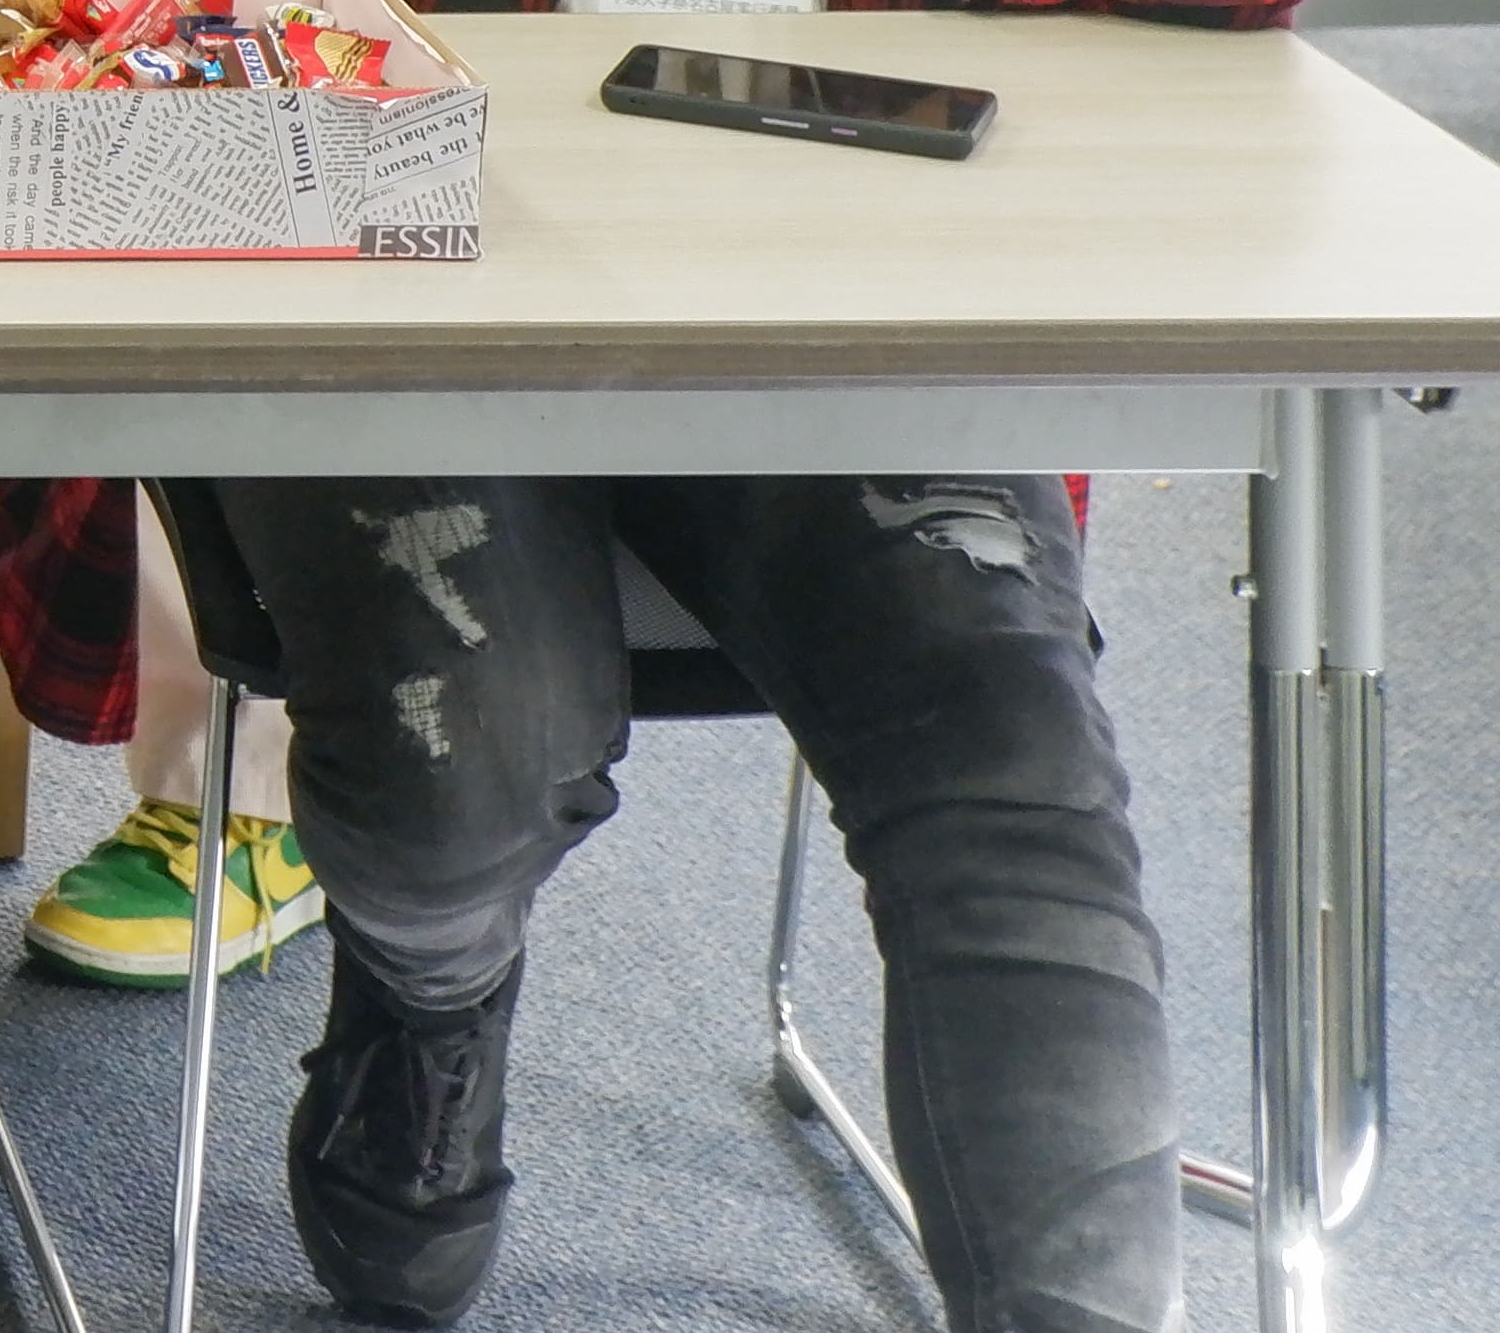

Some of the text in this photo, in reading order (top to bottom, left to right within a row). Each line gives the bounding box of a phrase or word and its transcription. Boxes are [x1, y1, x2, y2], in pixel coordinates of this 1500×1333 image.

[10, 113, 22, 151] when
[397, 122, 440, 148] what
[8, 155, 21, 178] the
[28, 153, 42, 175] the
[287, 120, 318, 195] Home
[373, 150, 434, 182] beauty
[23, 182, 37, 209] day
[49, 159, 68, 208] people
[364, 225, 478, 259] ESSIN
